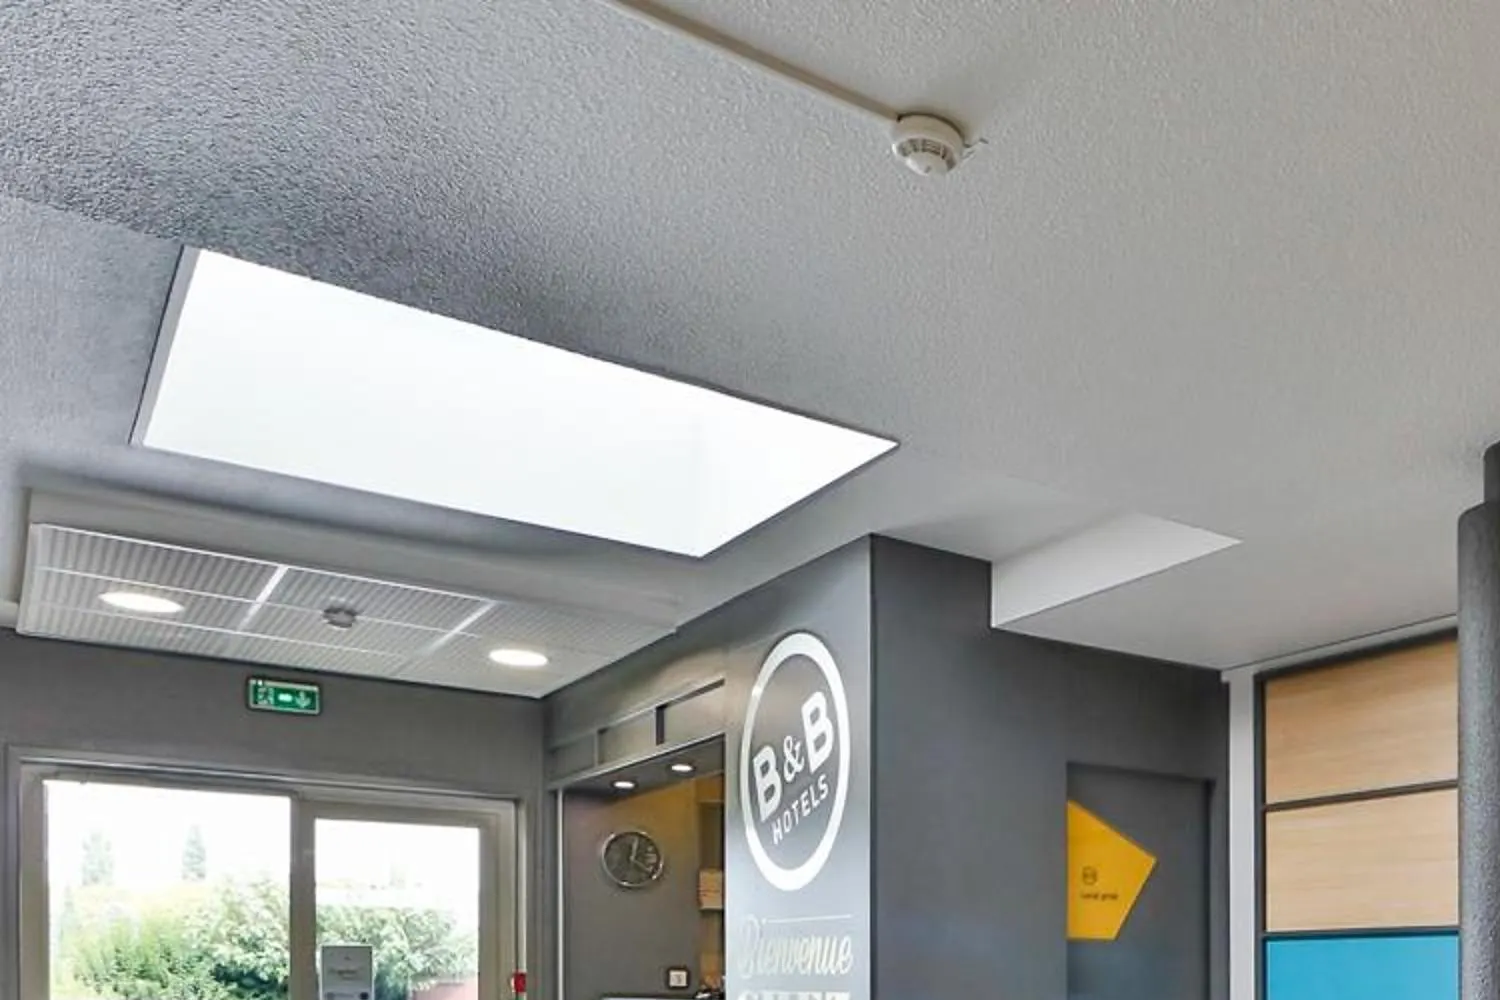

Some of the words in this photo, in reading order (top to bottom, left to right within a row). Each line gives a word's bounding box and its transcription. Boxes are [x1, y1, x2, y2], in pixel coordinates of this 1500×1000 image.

[752, 691, 835, 823] B&B
[770, 773, 830, 845] HOTELS
[737, 914, 853, 978] Bienvenue
